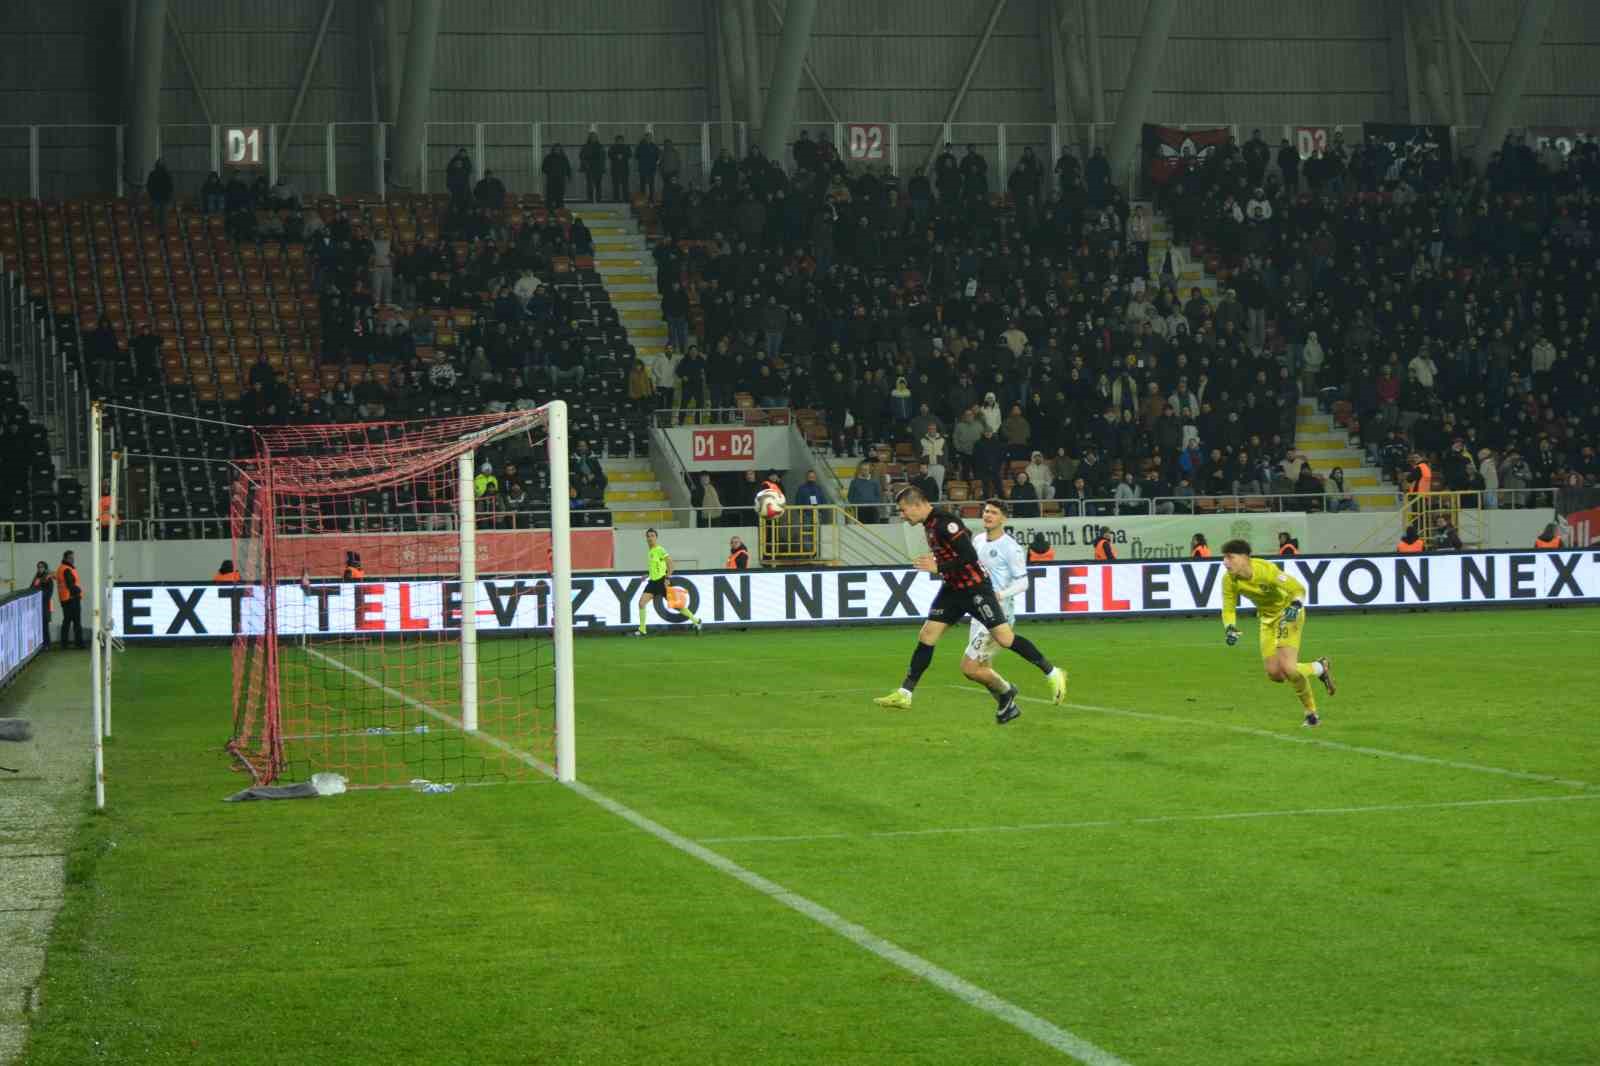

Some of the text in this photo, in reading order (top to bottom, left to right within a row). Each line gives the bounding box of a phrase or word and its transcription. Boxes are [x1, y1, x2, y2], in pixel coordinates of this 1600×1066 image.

[228, 129, 258, 161] D1
[851, 126, 882, 158] D2
[695, 435, 714, 456] D1
[731, 434, 752, 455] D2
[1004, 524, 1127, 546] Bağmlı Ola
[785, 571, 945, 618] NEX
[1026, 558, 1429, 612] TELEVYON
[1461, 553, 1600, 600] NEX
